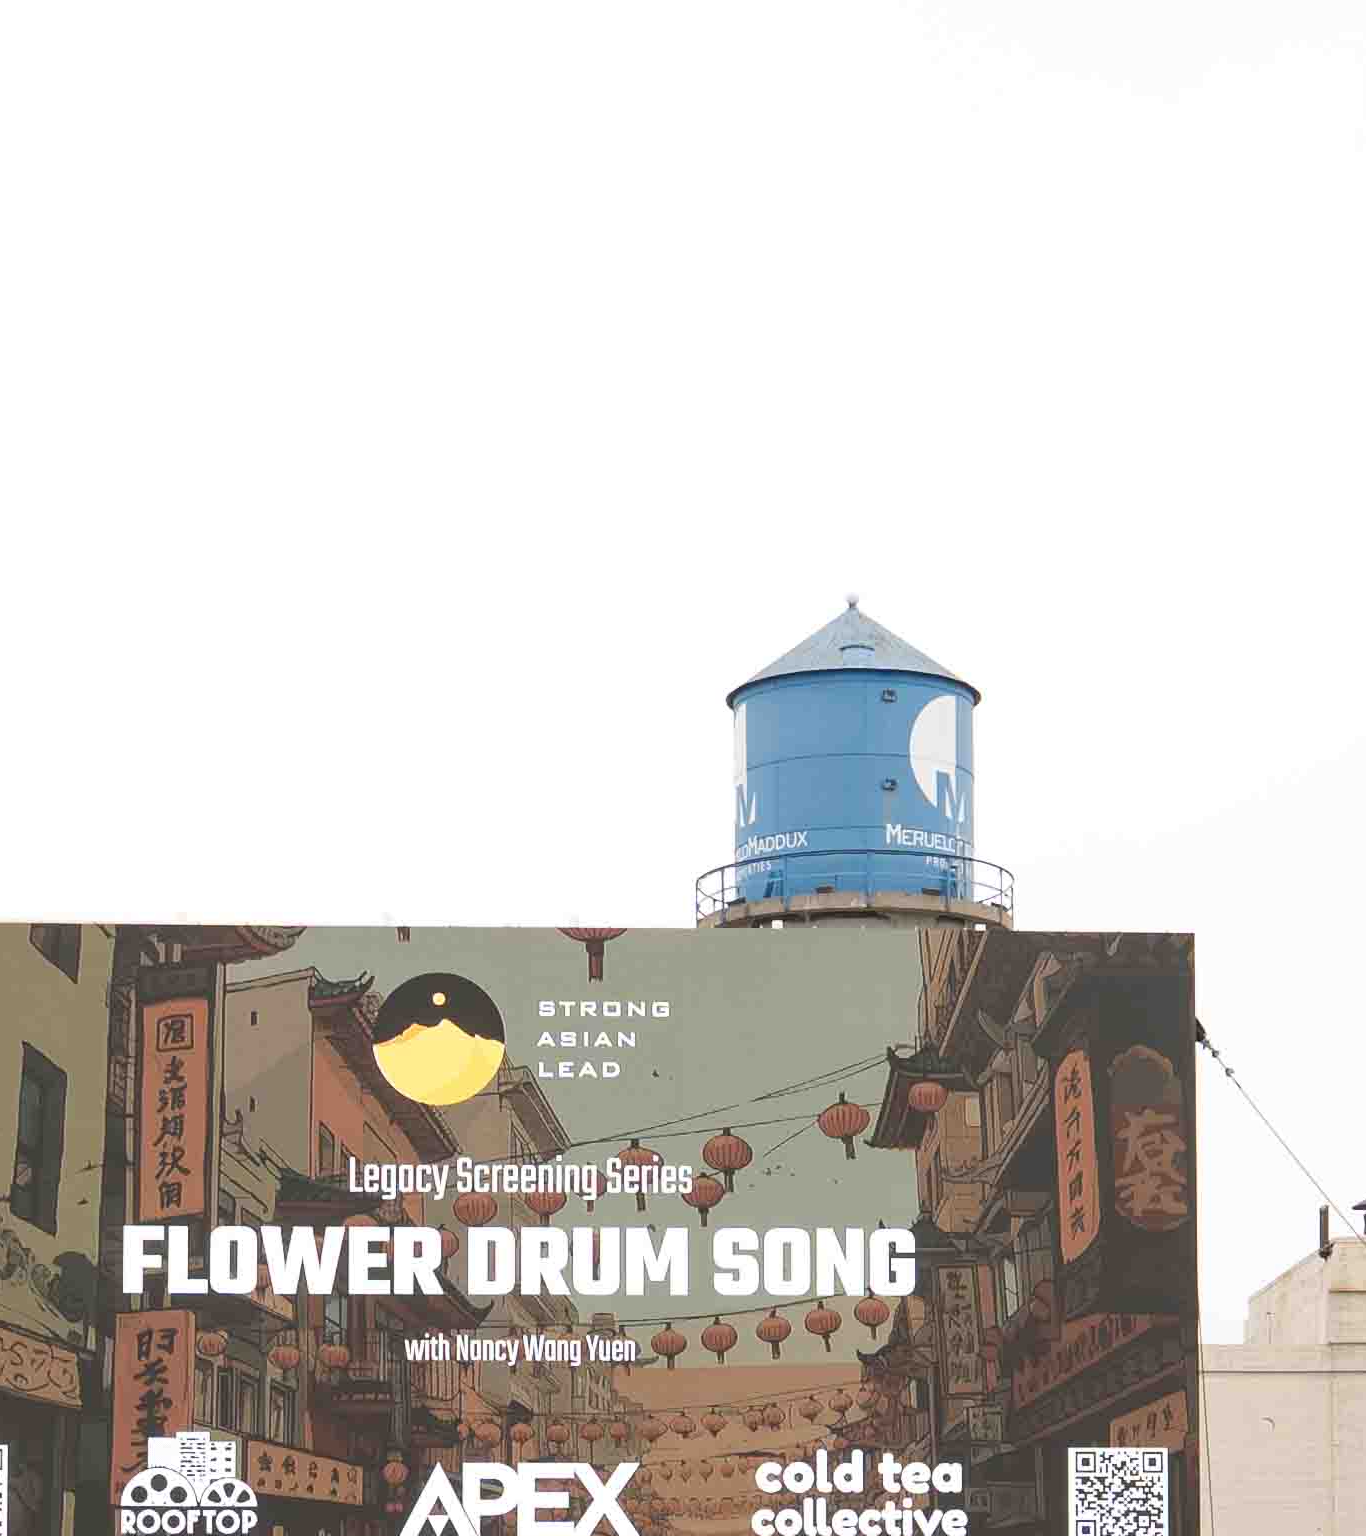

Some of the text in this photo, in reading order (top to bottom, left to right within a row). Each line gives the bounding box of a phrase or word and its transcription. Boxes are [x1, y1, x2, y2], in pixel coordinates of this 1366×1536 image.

[538, 1000, 671, 1018] STRONG
[537, 1031, 637, 1048] ASIAN
[538, 1061, 621, 1079] LEAD
[349, 1155, 693, 1201] Legacy Screening Series
[122, 1225, 916, 1297] FLOWER DRUM SONG
[404, 1333, 636, 1367] with Nancy Wang Yuen
[754, 1449, 963, 1494] cold tea
[120, 1509, 258, 1535] ROOFTOP
